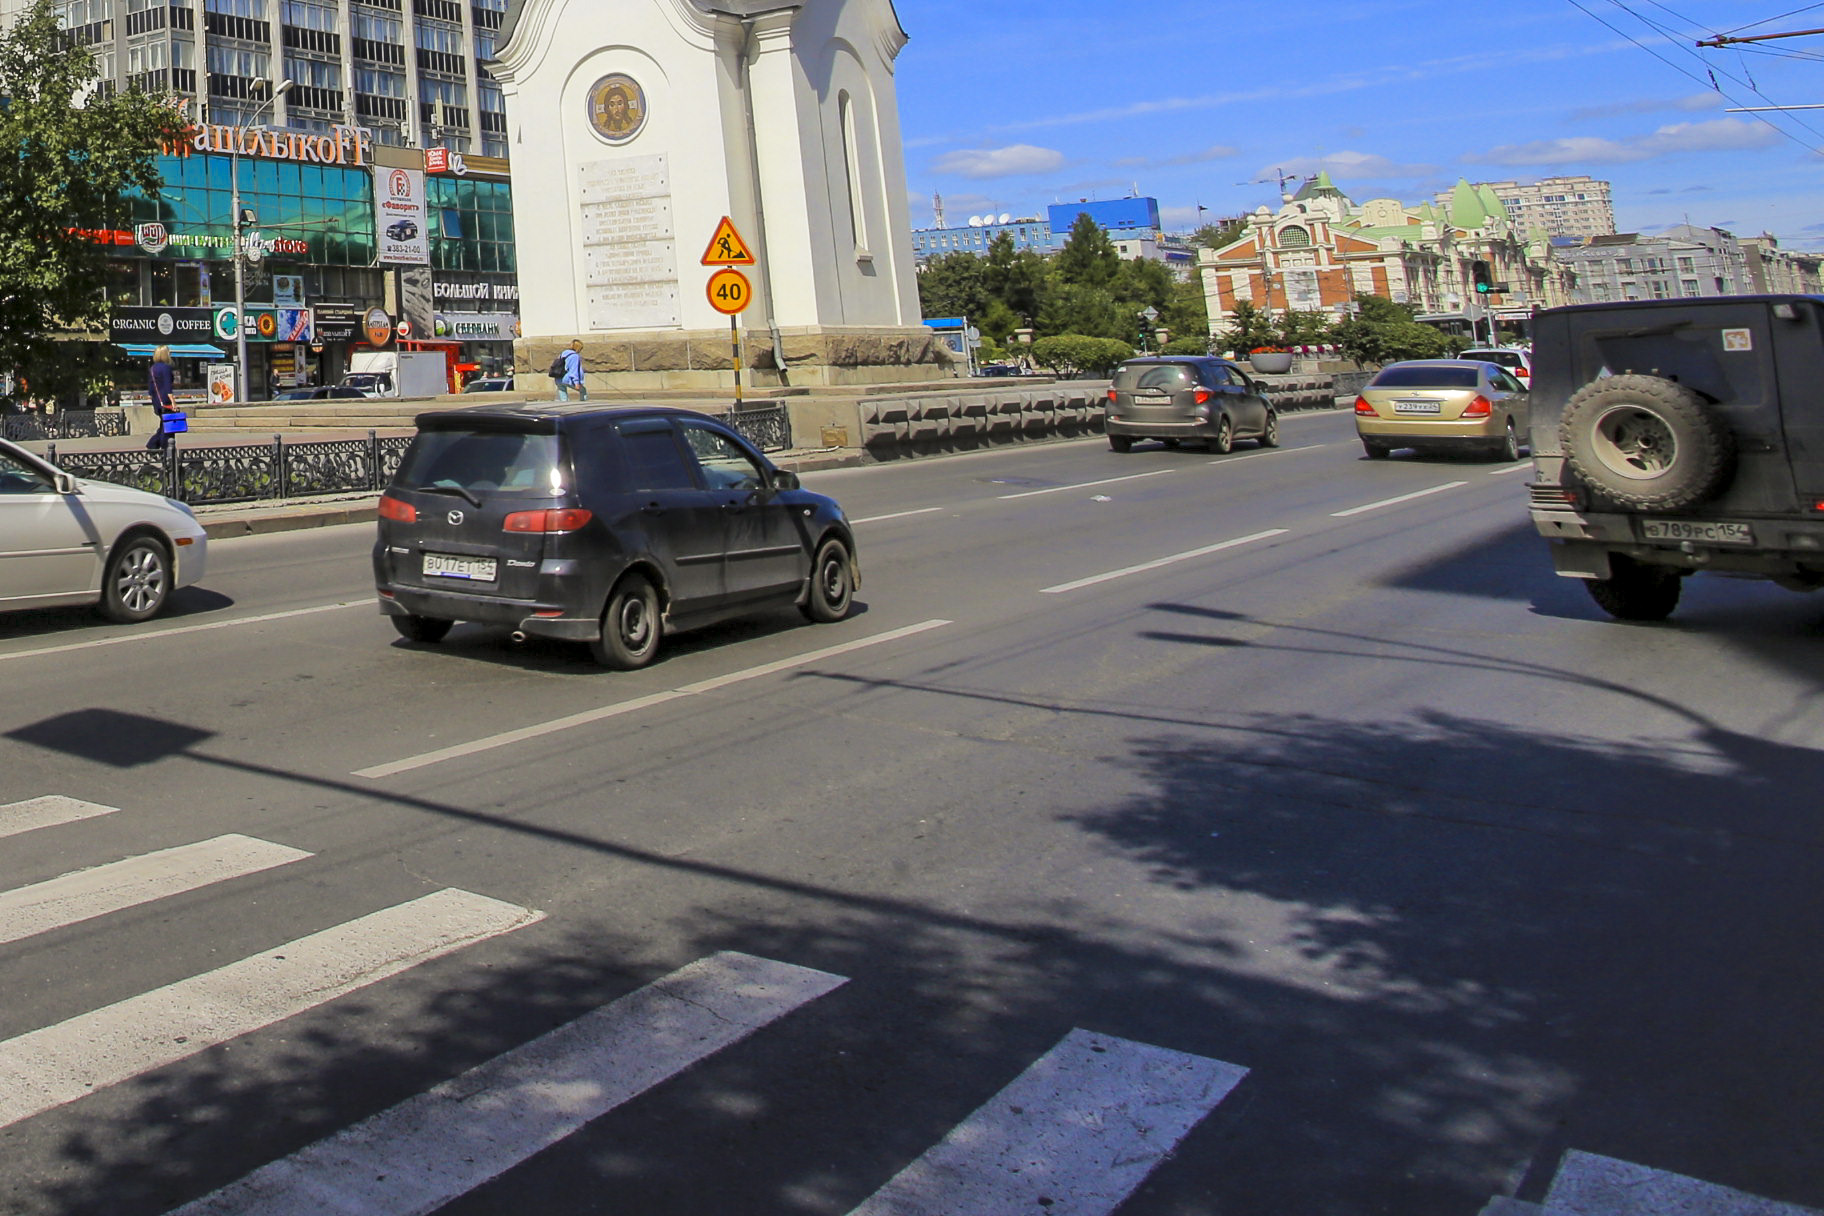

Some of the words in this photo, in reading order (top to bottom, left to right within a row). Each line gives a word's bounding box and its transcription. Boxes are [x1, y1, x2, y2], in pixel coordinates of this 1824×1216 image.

[193, 122, 373, 166] ашлыкоFF
[433, 282, 490, 299] БОЛЬШОЙ
[716, 284, 741, 300] 40
[112, 319, 156, 330] ORGANIC
[176, 319, 212, 330] COFFEE
